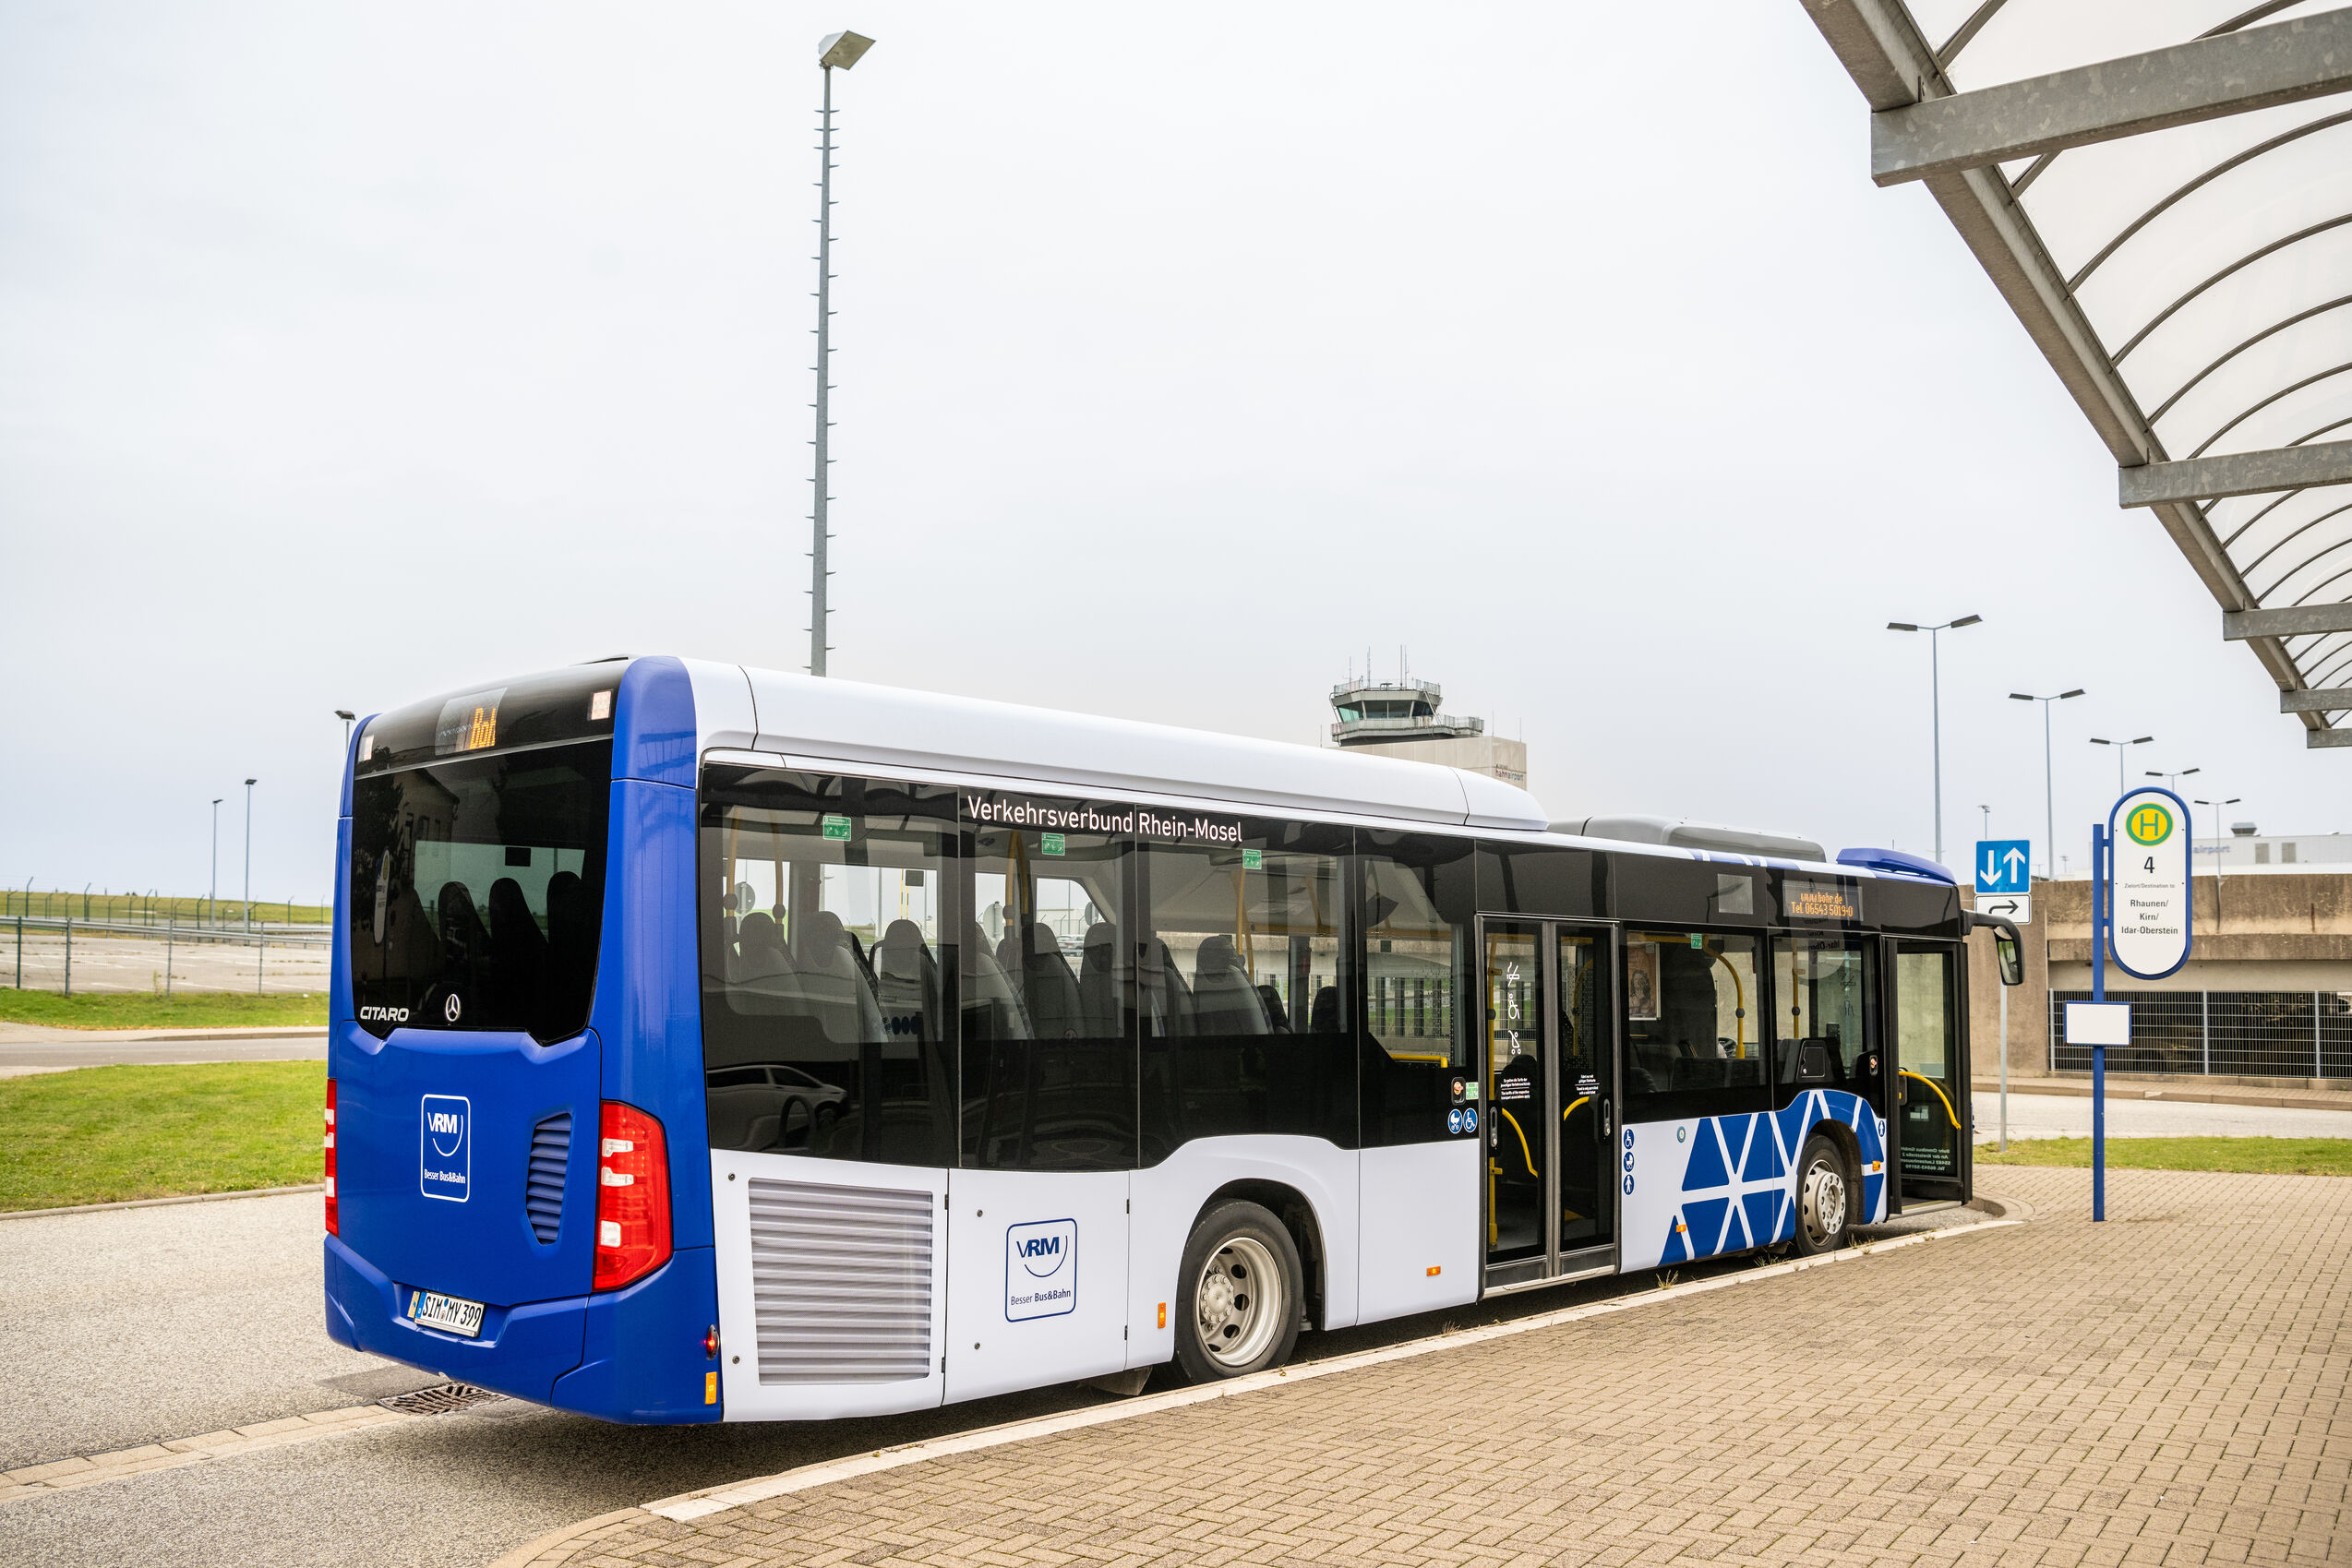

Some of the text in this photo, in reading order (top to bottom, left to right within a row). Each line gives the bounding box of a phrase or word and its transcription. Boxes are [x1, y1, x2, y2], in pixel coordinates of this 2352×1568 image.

[967, 796, 1242, 843] Verkehrsverbund Rhein-Mosel
[2140, 813, 2158, 836] H
[2193, 844, 2230, 855] airport
[2143, 856, 2155, 874] 4
[1800, 892, 1842, 904] www.bohr.de
[2130, 899, 2169, 907] Rhaunen/
[1806, 902, 1827, 916] 06543
[1829, 904, 1854, 917] 5019-0
[2140, 913, 2159, 921] Kirn/
[2121, 926, 2178, 935] Idar-Oberstein
[360, 1006, 409, 1022] CITARO
[427, 1112, 457, 1133] VRM
[424, 1168, 465, 1184] Besser Bus&Bahn
[1016, 1237, 1060, 1258] VRM
[1011, 1288, 1071, 1306] Besser Bus&Bahn
[423, 1296, 482, 1327] SIM MY 399
